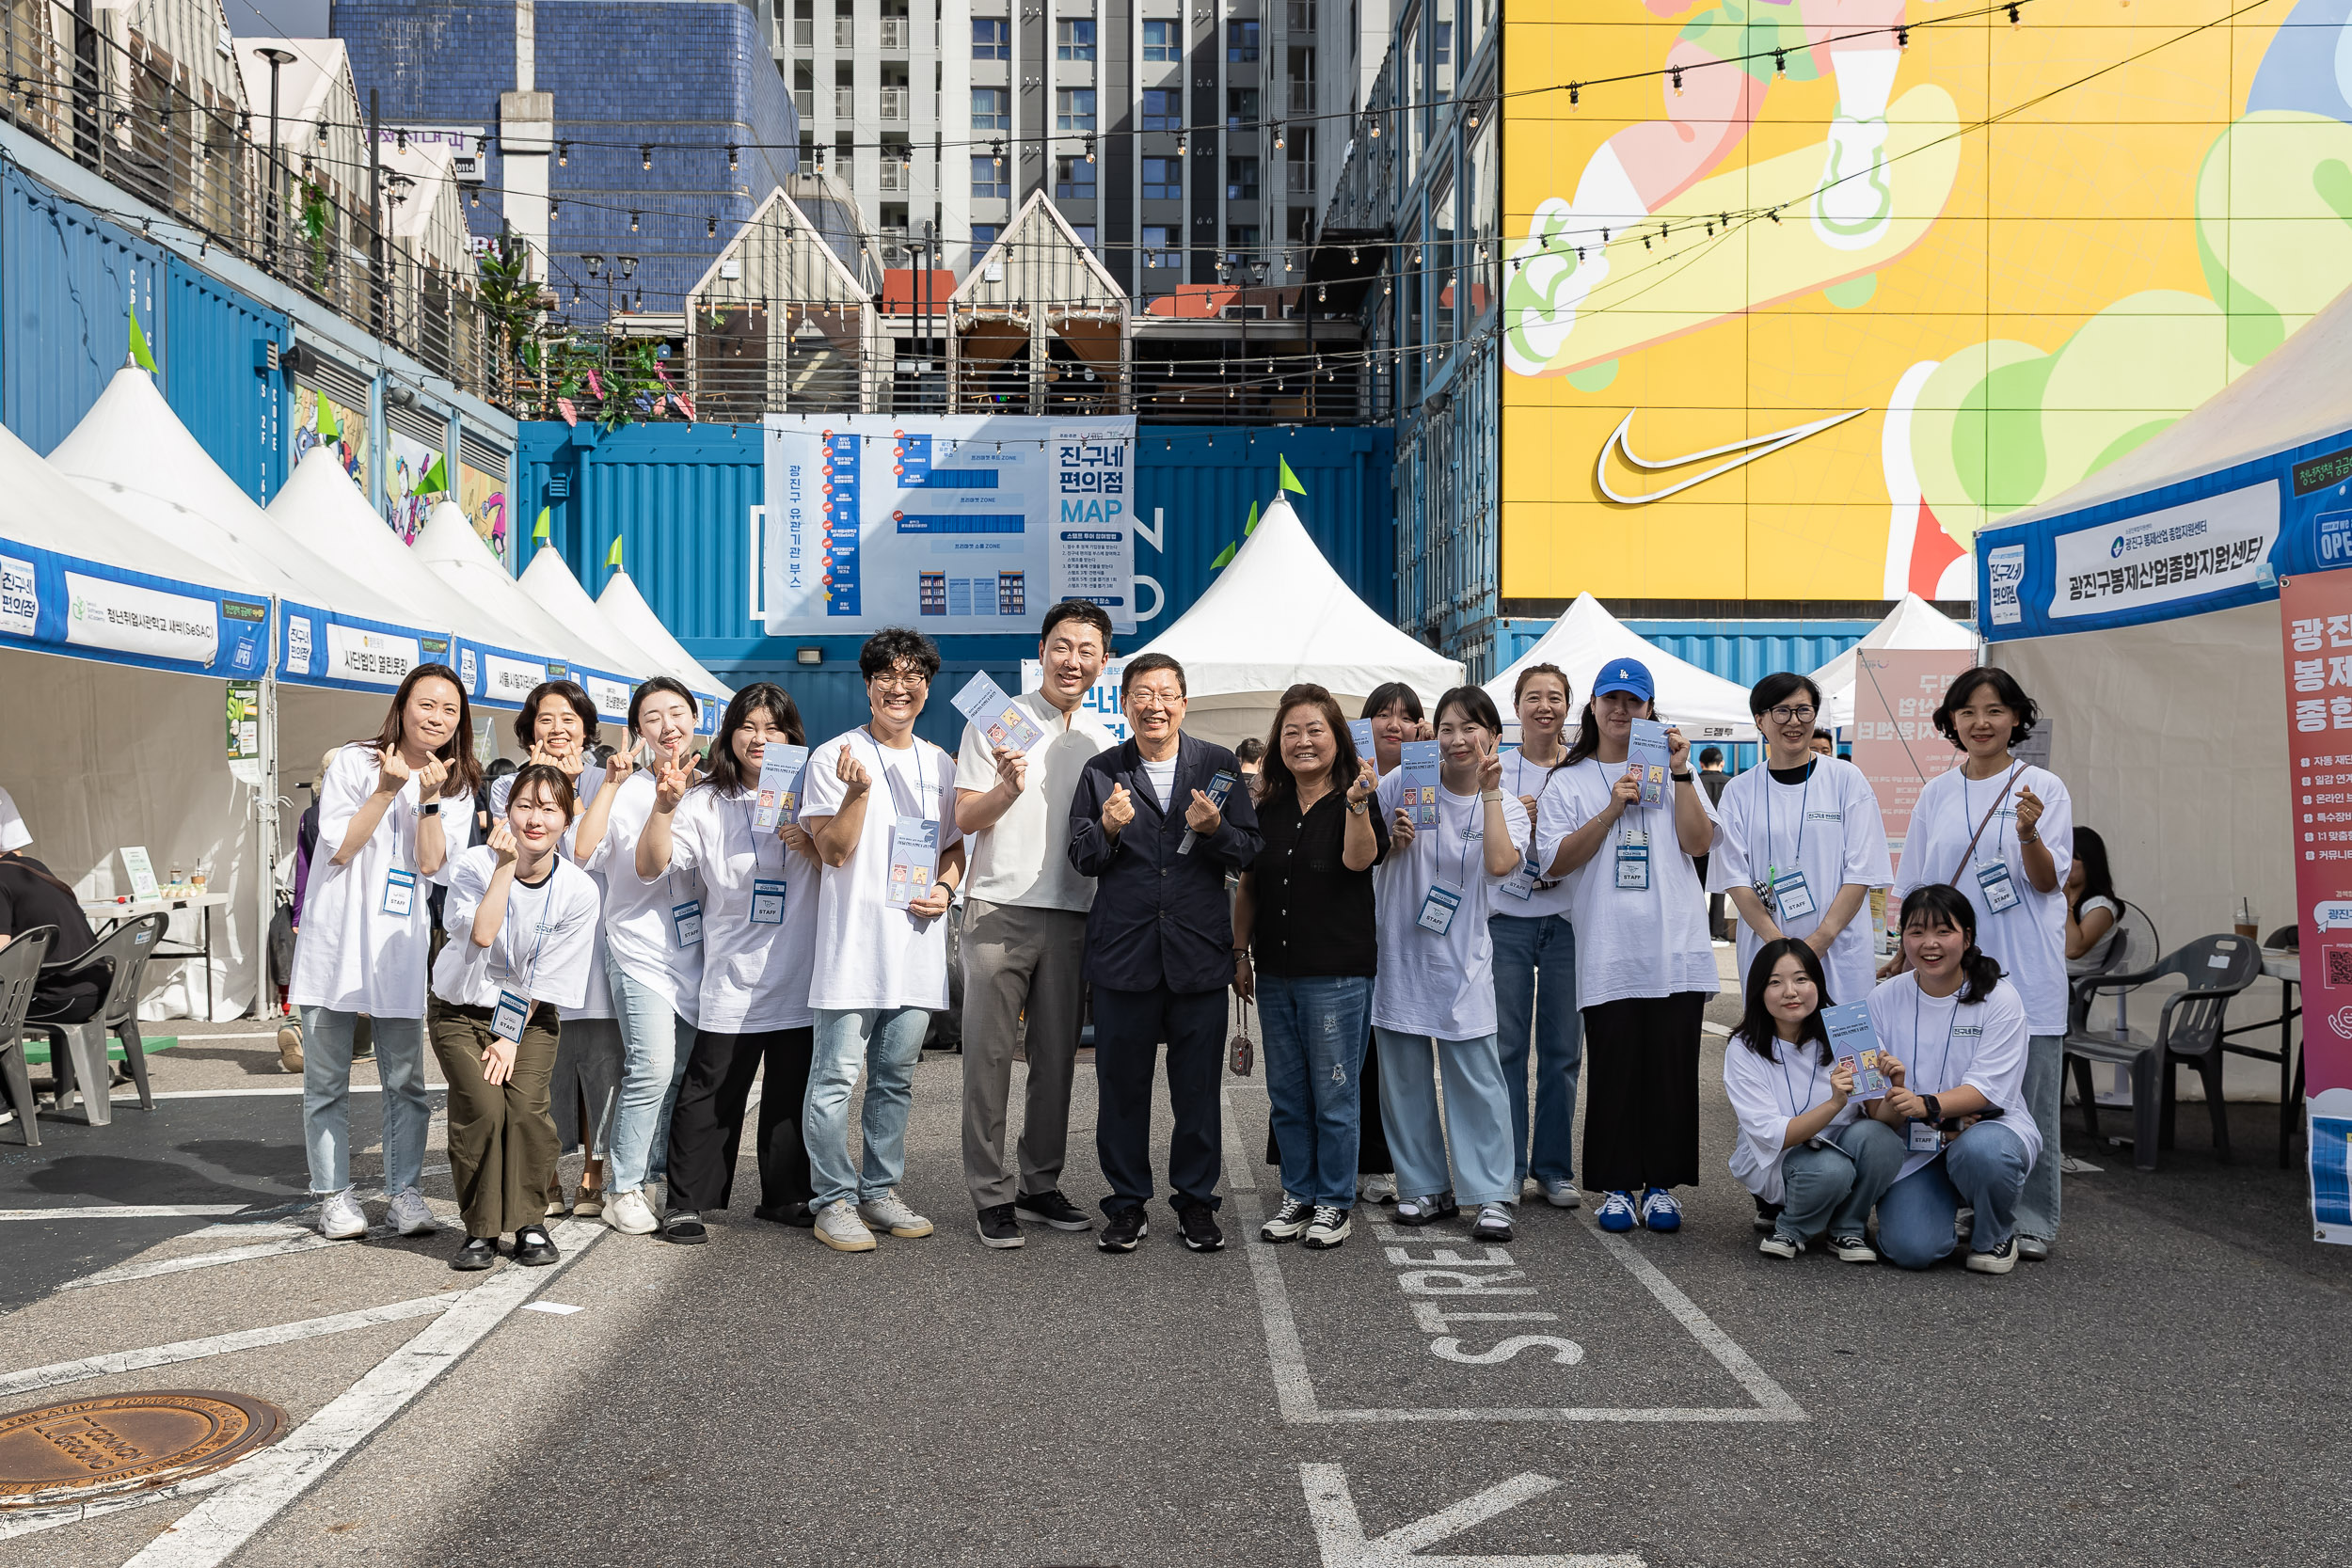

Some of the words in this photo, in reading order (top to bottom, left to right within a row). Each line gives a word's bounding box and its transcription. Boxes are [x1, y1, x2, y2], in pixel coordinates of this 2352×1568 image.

[1059, 446, 1124, 467] 진구네
[2299, 460, 2334, 486] 청년정책
[2335, 456, 2352, 477] 궁금
[789, 465, 801, 503] 광진구
[1059, 471, 1123, 494] 편의점
[1060, 499, 1122, 523] MAP
[789, 508, 801, 559] 유관기관
[2126, 535, 2143, 551] 광진구
[2144, 529, 2169, 546] 봉제산업
[2169, 519, 2207, 542] 종합지원센터
[789, 563, 801, 588] 부스
[2069, 536, 2264, 601] 광진구봉제산업종합지원센터
[2, 594, 36, 618] 편의점
[107, 608, 167, 631] 청년취업사관학교
[169, 619, 214, 640] 새싹(SeSAC)
[344, 650, 376, 673] 사단법인
[378, 655, 408, 676] 열린옷장
[1620, 669, 1629, 679] LA
[2313, 756, 2333, 767] 자동
[2315, 776, 2334, 785] 일감
[2315, 794, 2344, 804] 온라인
[2316, 812, 2352, 823] 특수장비
[1788, 901, 1805, 911] STAFF
[1994, 894, 2010, 903] STAFF
[1426, 915, 1443, 925] STAFF
[684, 929, 699, 939] STAFF
[500, 1021, 516, 1032] STAFF
